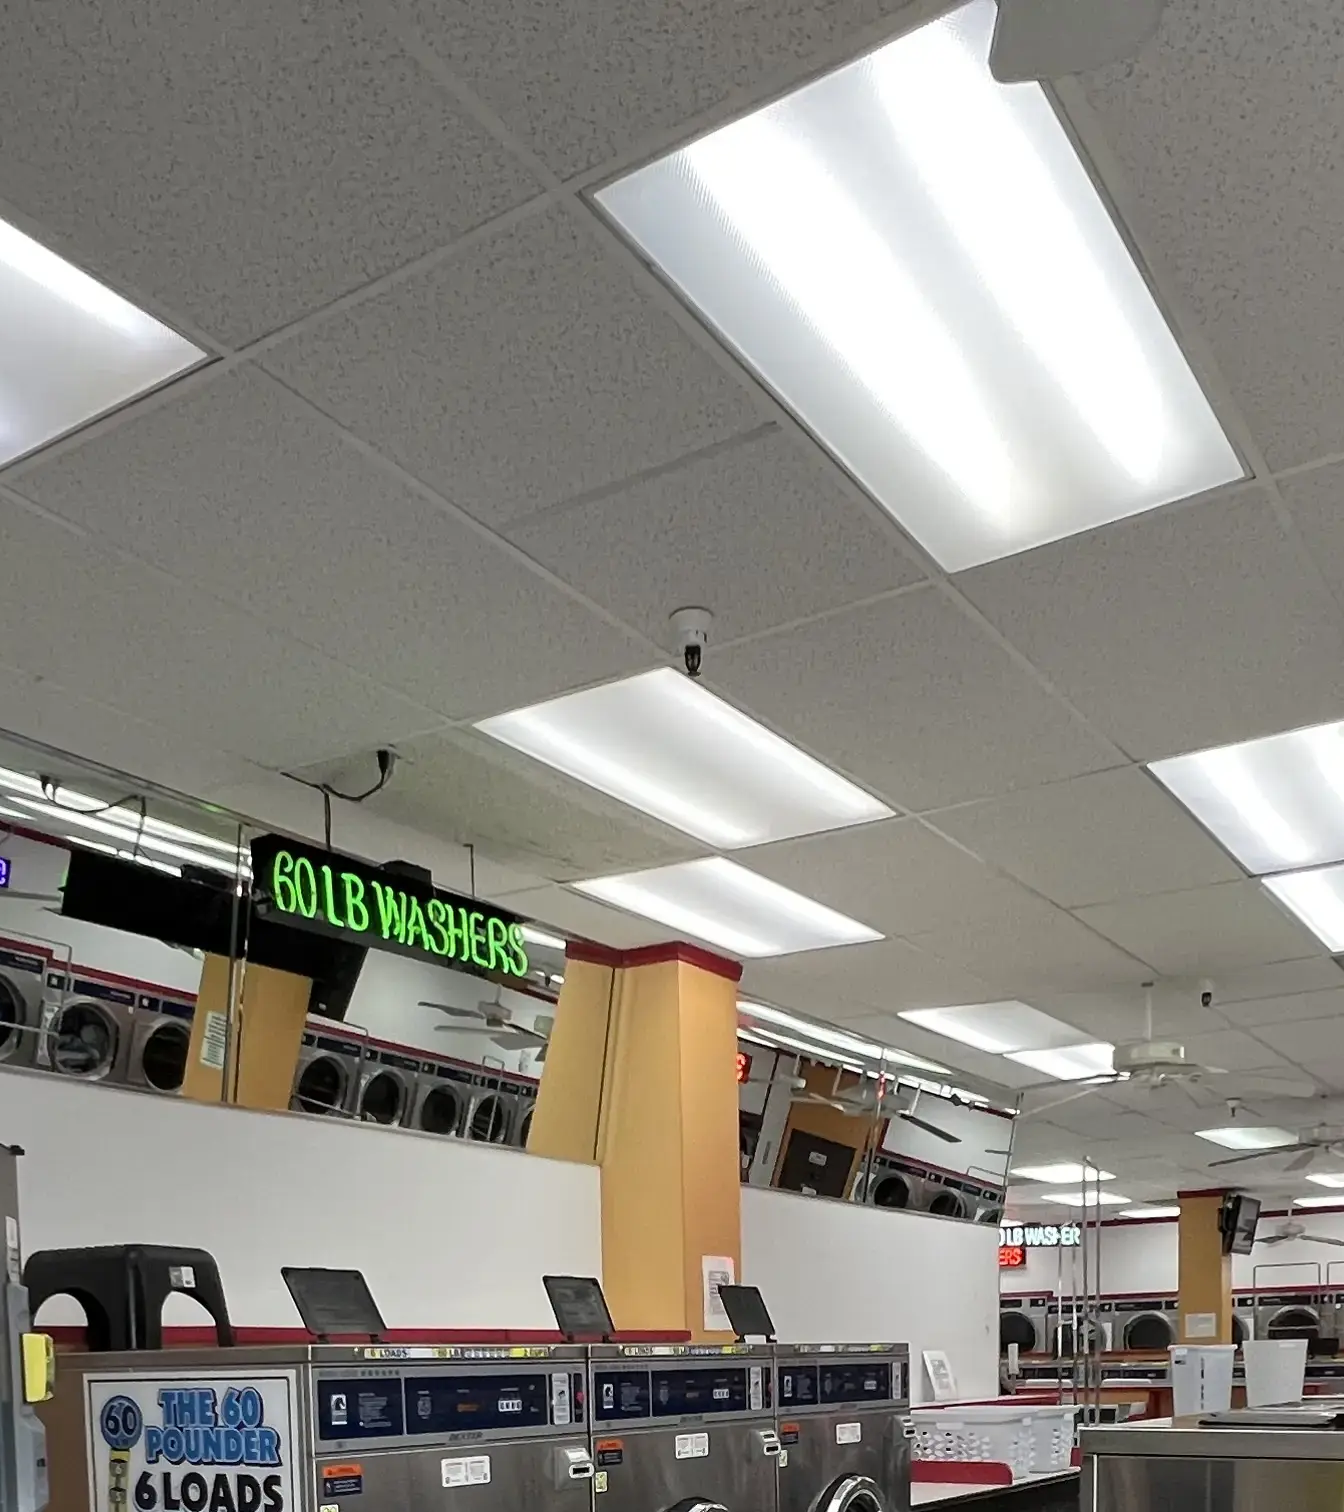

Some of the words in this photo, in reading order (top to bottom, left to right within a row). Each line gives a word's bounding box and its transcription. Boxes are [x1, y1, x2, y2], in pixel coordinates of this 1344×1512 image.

[273, 850, 317, 919] 60
[322, 864, 369, 932] LB
[372, 881, 528, 977] WASHERS
[1006, 1227, 1024, 1247] LB
[104, 1401, 139, 1439] 60
[158, 1388, 217, 1428] THE
[221, 1387, 263, 1429] 60
[145, 1426, 283, 1466] POUNDER
